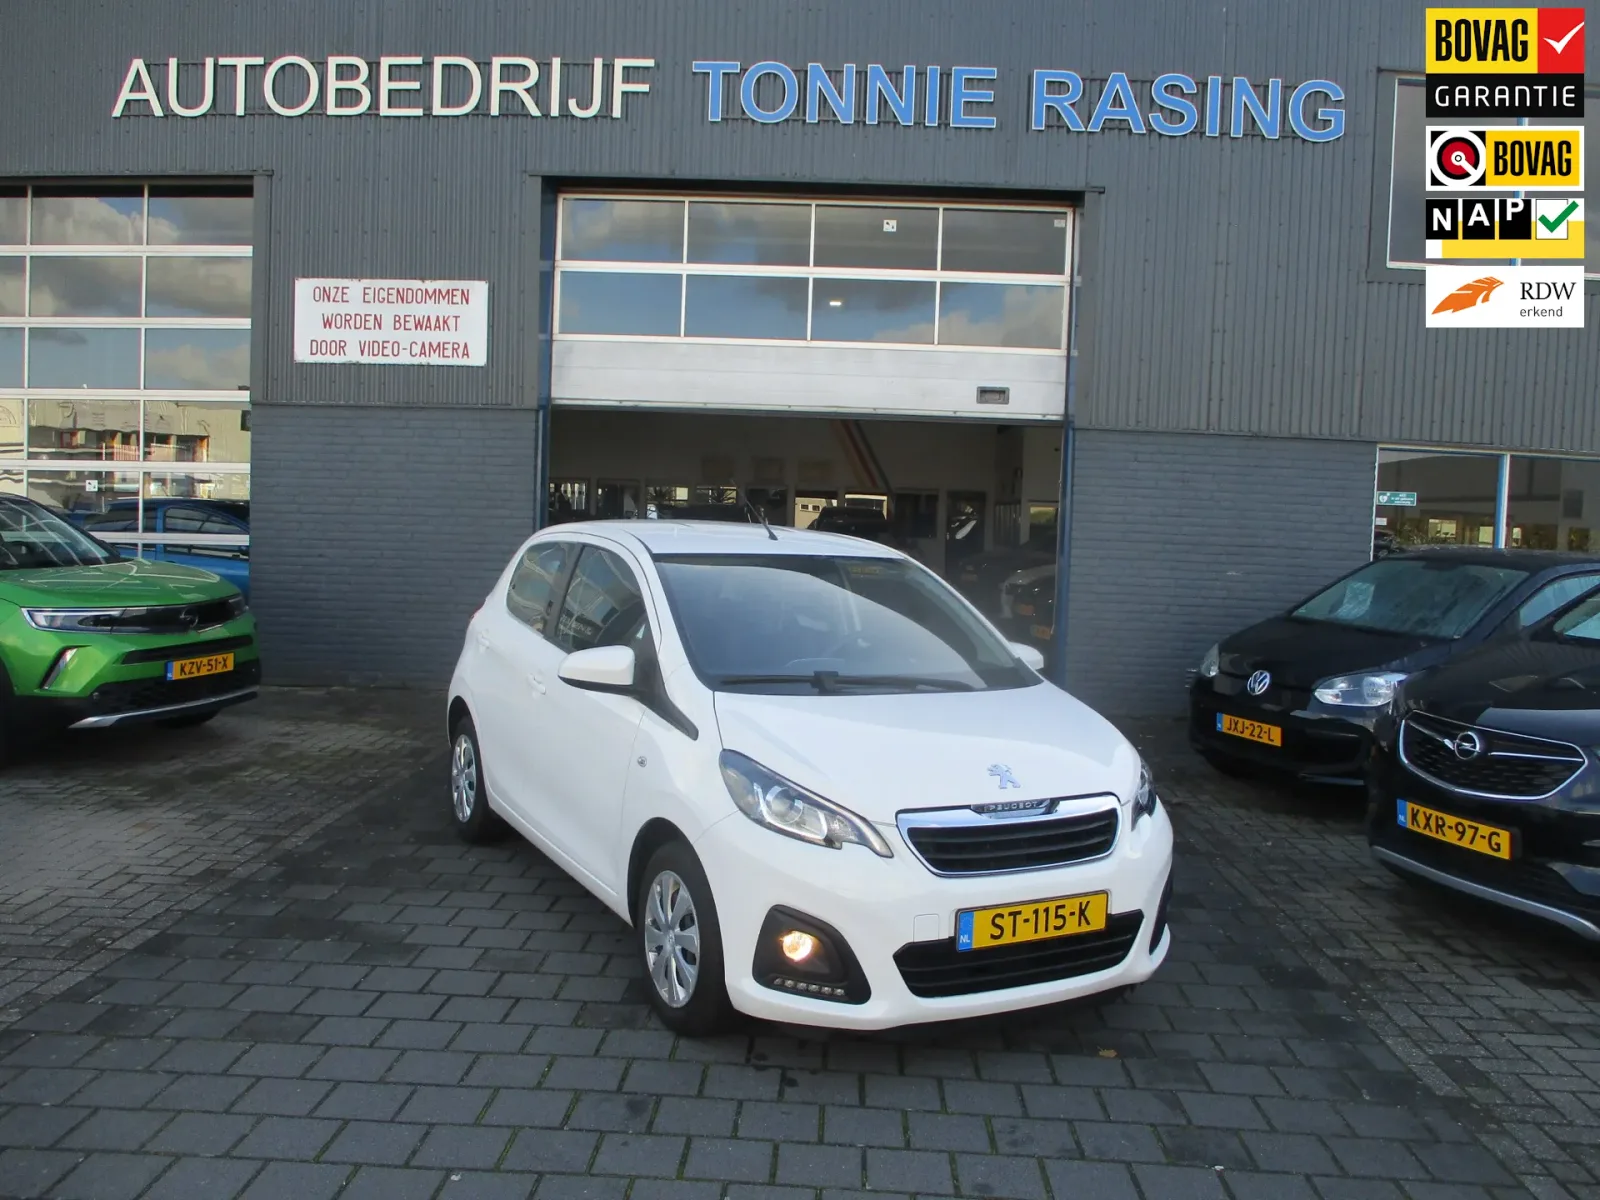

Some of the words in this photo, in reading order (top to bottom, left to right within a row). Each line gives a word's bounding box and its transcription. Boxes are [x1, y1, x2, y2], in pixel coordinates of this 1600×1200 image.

[111, 55, 655, 119] AUTOBEDRIJF
[692, 60, 998, 129] TONNIE
[1031, 69, 1346, 143] RASING
[312, 286, 350, 303] ONZE
[362, 287, 470, 305] EIGENDOMMEN
[321, 313, 383, 331] WORDEN
[392, 314, 461, 332] BEWAAKT
[309, 339, 347, 356] DOOR
[358, 339, 471, 359] VIDEO-CAMERA
[179, 656, 229, 677] KZV-51-X
[1226, 717, 1275, 742] JXJ-22-L
[1410, 806, 1501, 853] KXR-97-G
[959, 934, 971, 944] NL
[989, 900, 1091, 940] ST-115-K
